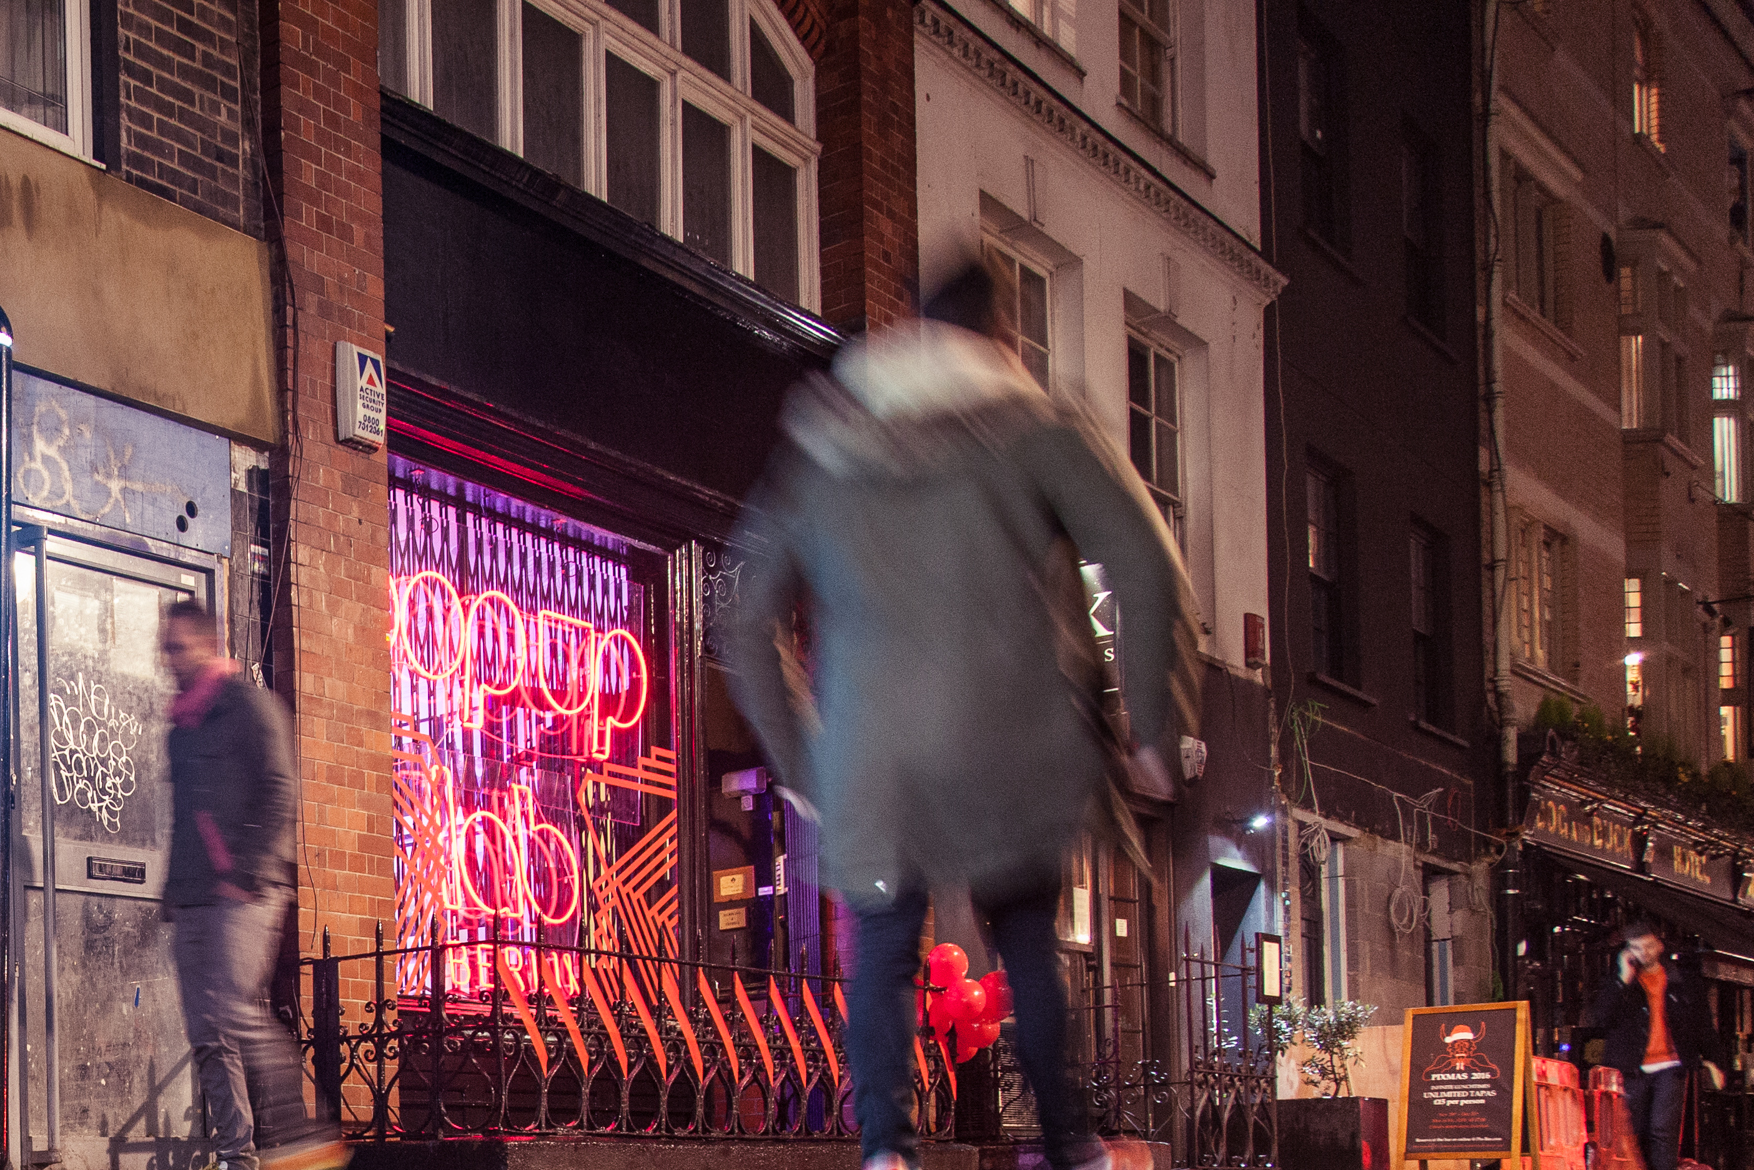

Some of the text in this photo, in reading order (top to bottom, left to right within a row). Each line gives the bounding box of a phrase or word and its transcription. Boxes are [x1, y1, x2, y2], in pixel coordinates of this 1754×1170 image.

[359, 386, 384, 400] ACTIVE
[359, 393, 384, 408] SECURITY
[362, 402, 382, 414] GROUP
[363, 414, 379, 427] 0800
[389, 570, 528, 730] op
[432, 764, 580, 925] lab
[1430, 1073, 1469, 1081] PIXMAS
[1459, 1099, 1486, 1107] person
